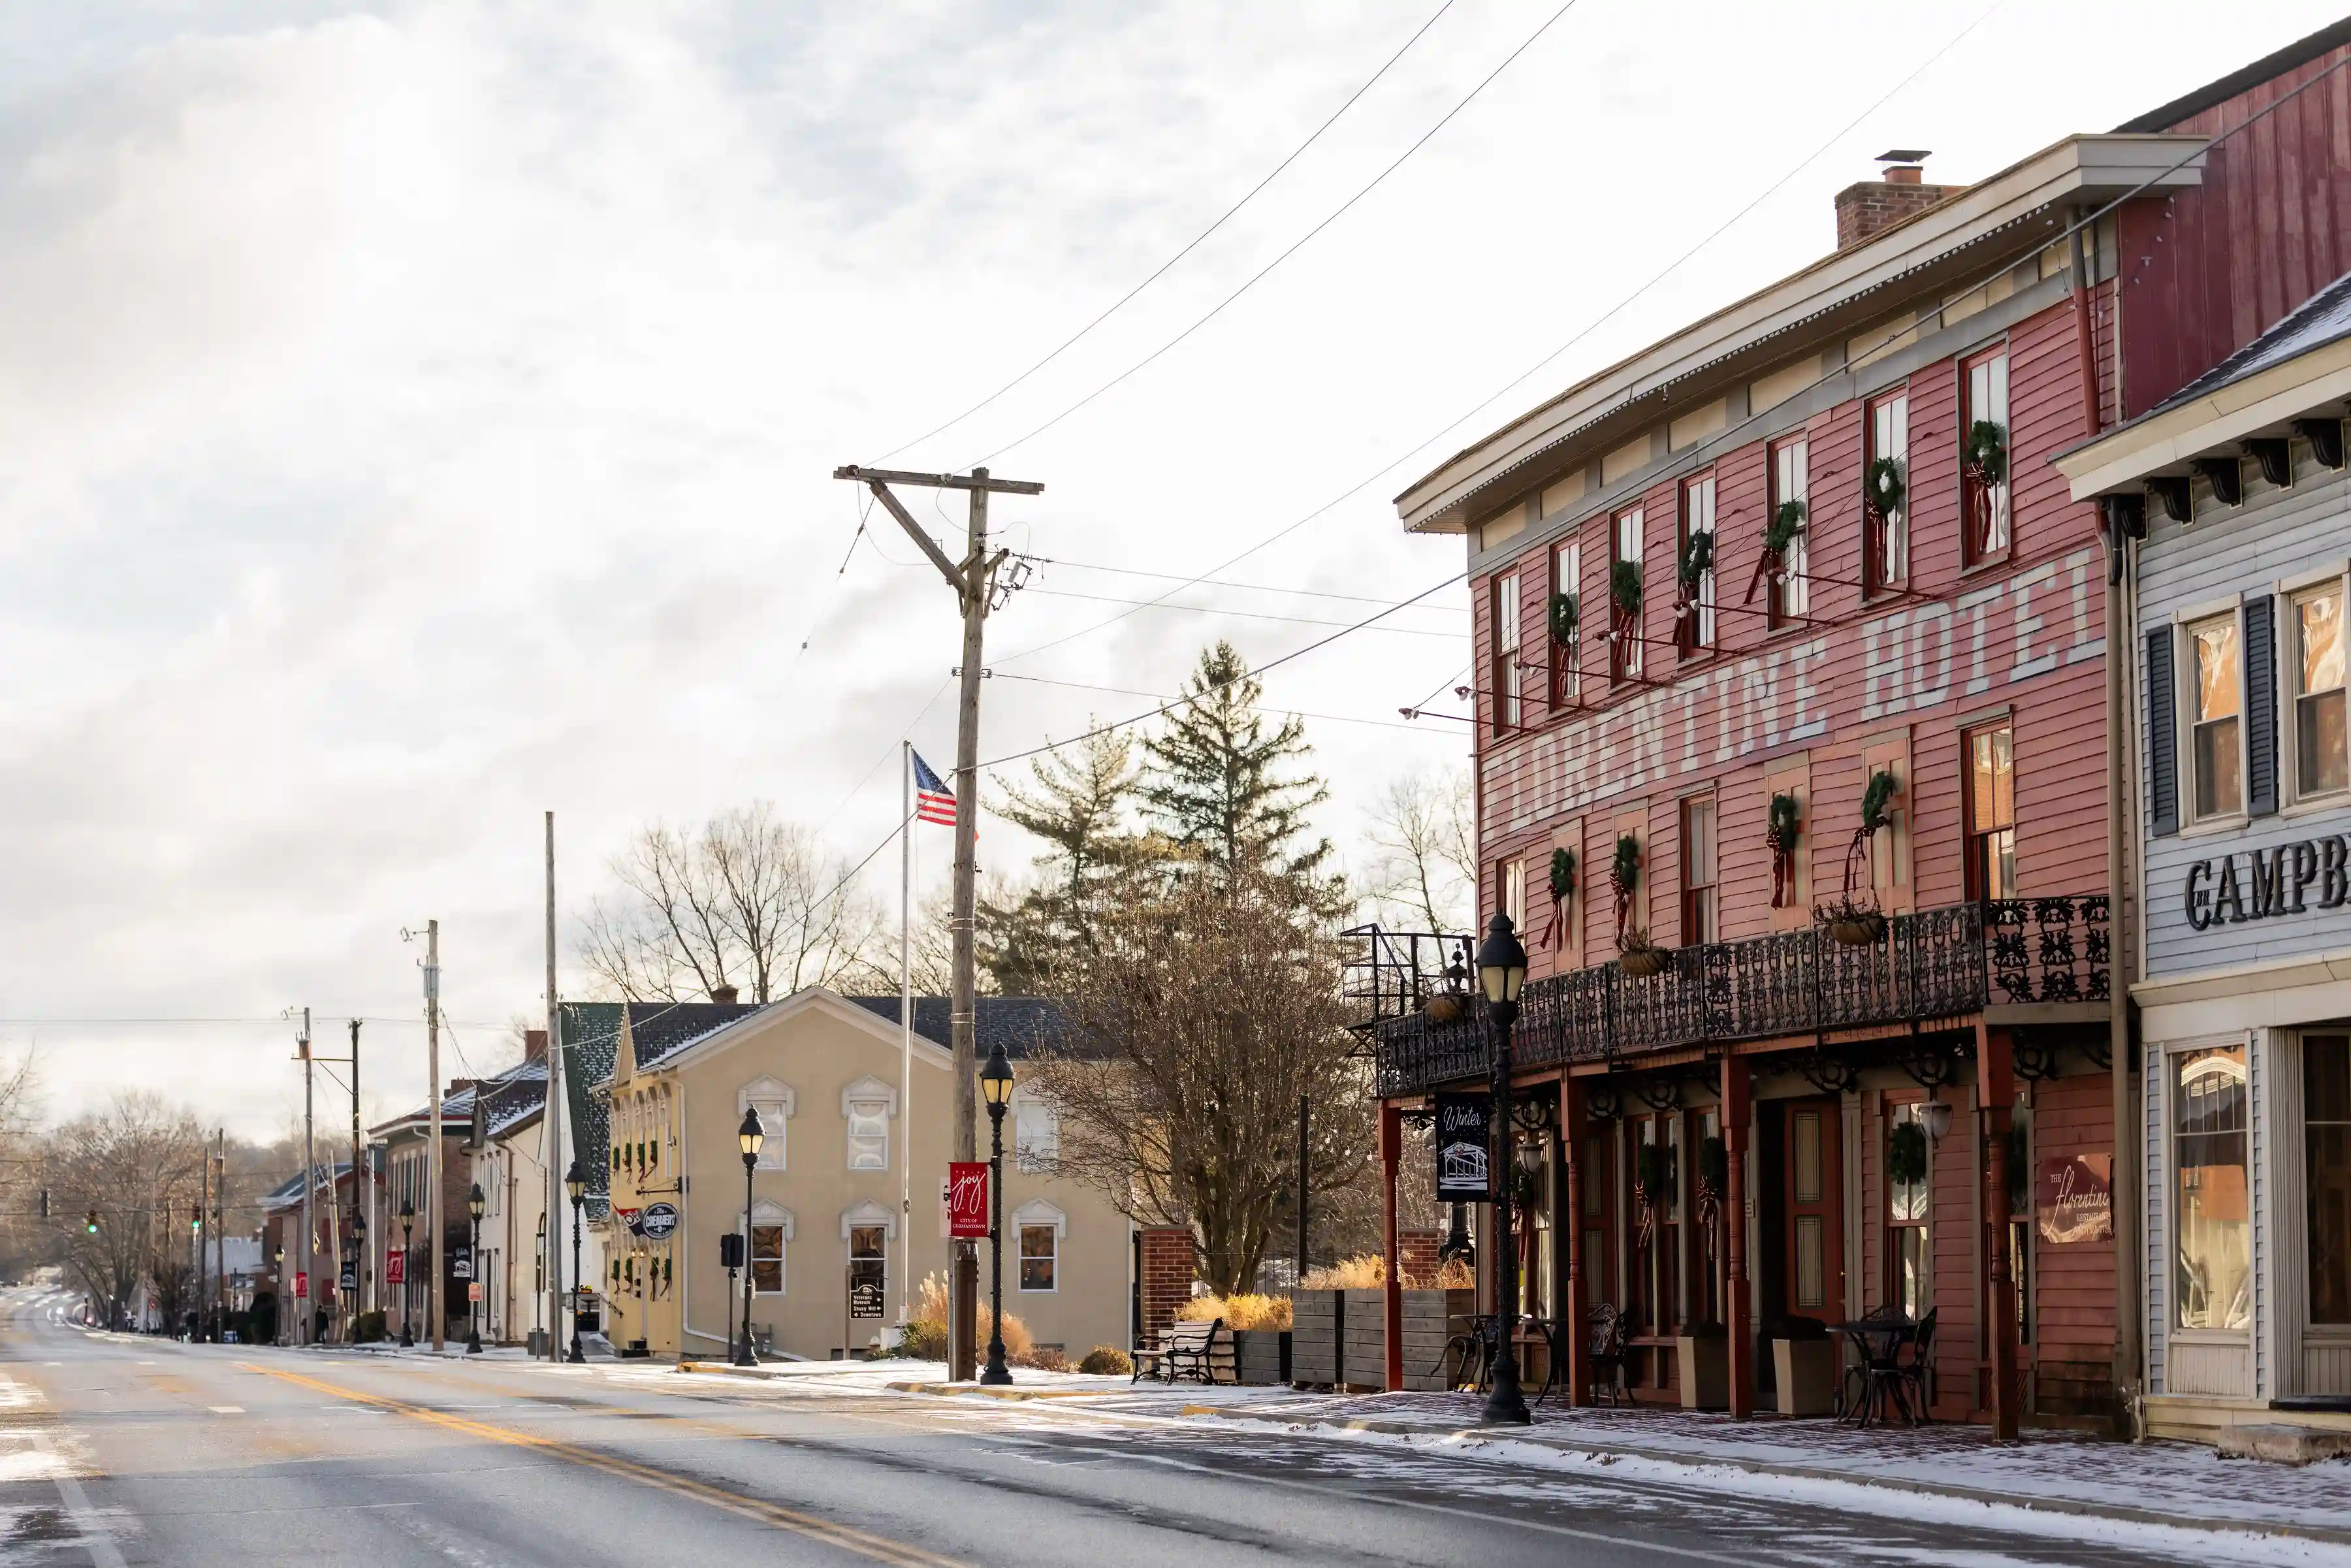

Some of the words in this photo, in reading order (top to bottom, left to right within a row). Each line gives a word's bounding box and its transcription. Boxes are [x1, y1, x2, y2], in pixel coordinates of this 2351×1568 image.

[1481, 637, 1827, 844] FLORENTINE
[1861, 549, 2107, 721] HOTEL
[2184, 834, 2351, 931] CAMPB
[1443, 1106, 1482, 1131] Winter
[2051, 1174, 2062, 1183] THE
[952, 1170, 986, 1214] joy
[645, 1214, 676, 1227] CREAMERY
[2076, 1211, 2109, 1222] RESTAURANT
